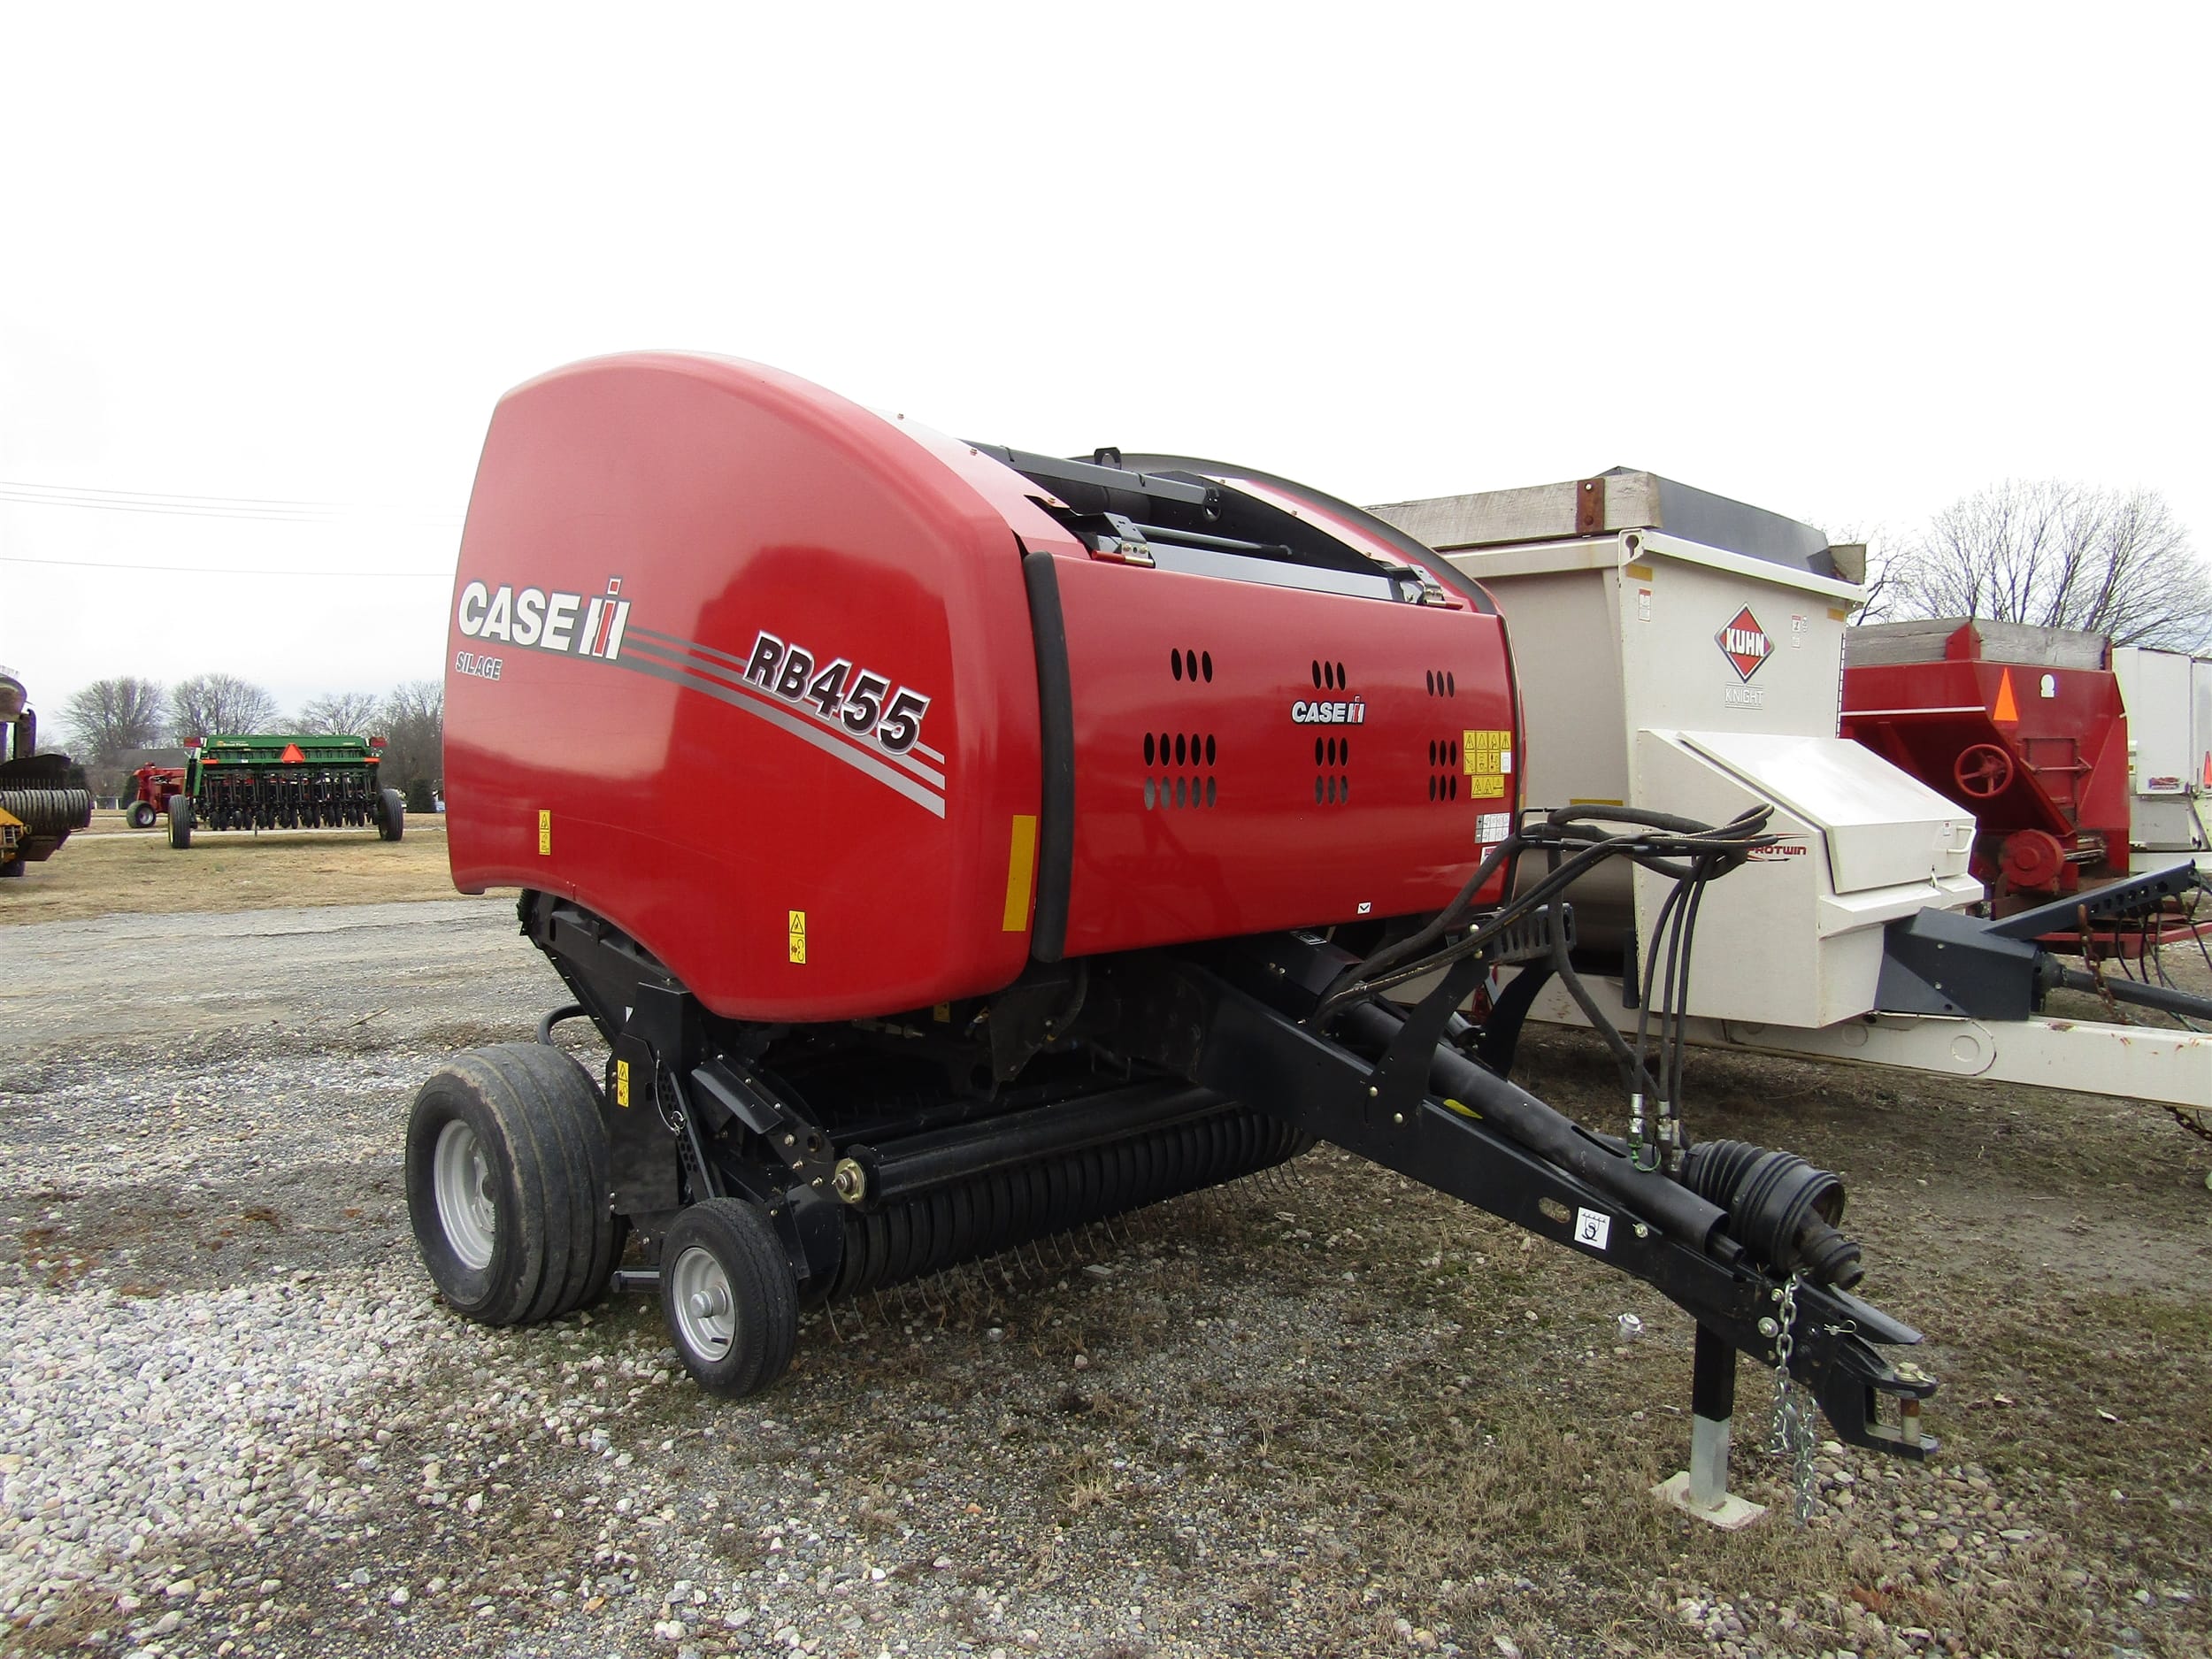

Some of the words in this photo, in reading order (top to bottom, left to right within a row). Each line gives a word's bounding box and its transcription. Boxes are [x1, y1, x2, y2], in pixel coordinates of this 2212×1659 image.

[457, 580, 582, 652] CASE
[1725, 626, 1765, 657] KUHN
[455, 650, 503, 681] SILAGE
[742, 629, 932, 757] RB455
[1724, 687, 1764, 706] KNIGHT
[1292, 700, 1347, 724] CASE
